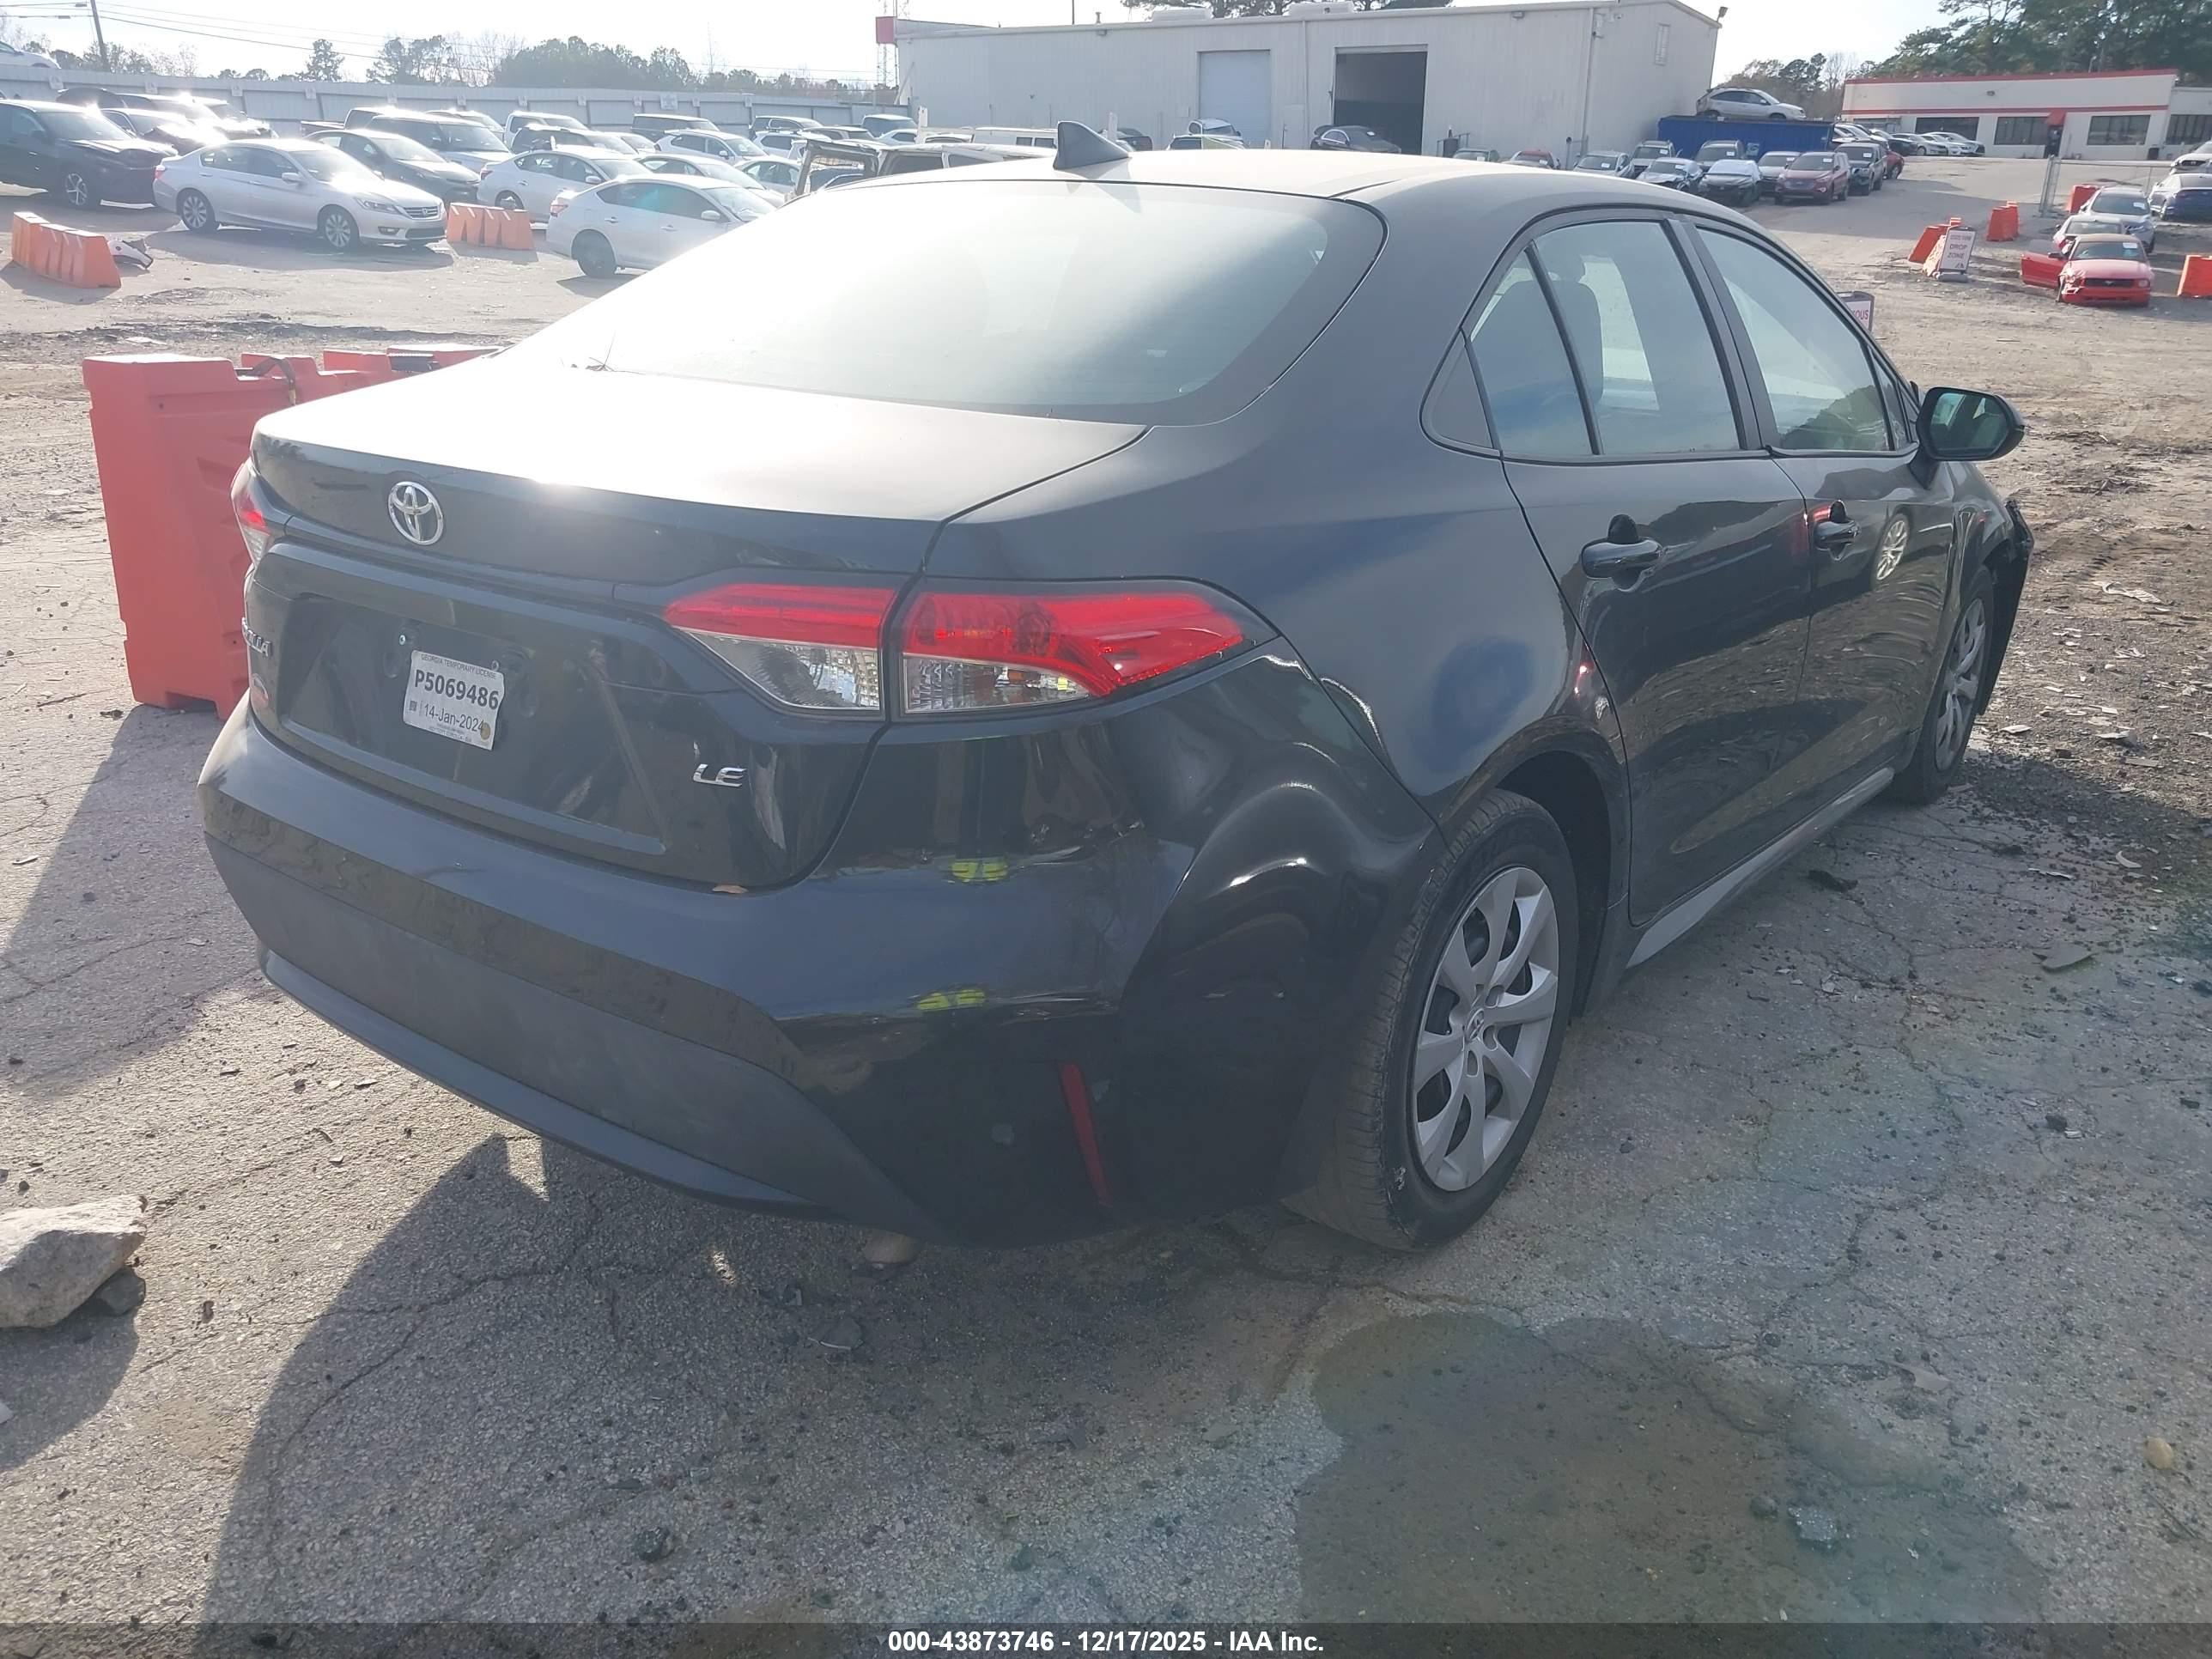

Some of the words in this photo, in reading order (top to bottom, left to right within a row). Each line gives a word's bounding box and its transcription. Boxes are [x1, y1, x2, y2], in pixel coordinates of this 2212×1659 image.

[421, 653, 443, 664] GEORGIA
[444, 659, 476, 673] TEMPORARY
[476, 668, 497, 679] LICENSE
[414, 669, 499, 710] P5069486
[692, 763, 747, 787] LE
